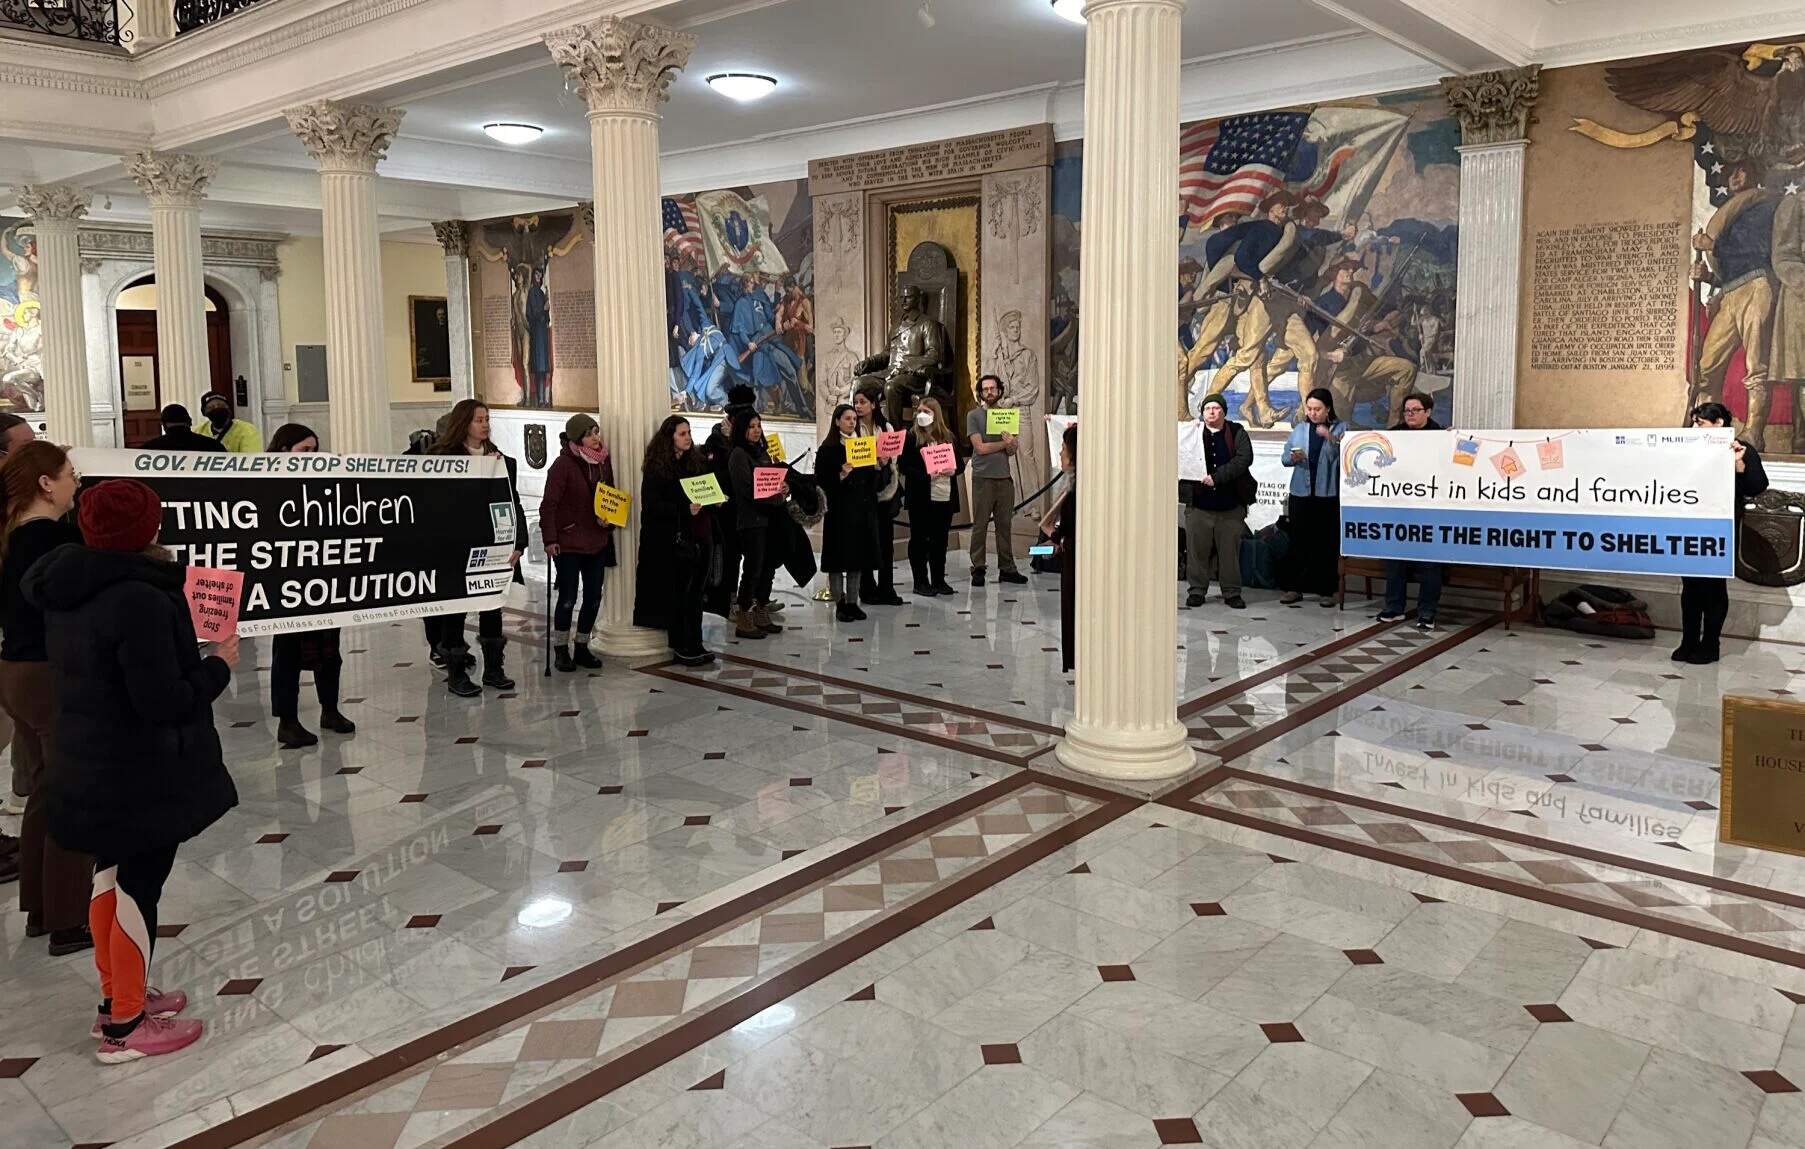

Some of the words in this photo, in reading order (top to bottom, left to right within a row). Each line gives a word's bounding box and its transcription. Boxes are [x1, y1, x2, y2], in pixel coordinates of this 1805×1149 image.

[134, 453, 187, 471] GOV.
[192, 456, 282, 472] HEALEY:
[286, 456, 341, 473] STOP
[345, 457, 418, 473] SHELTER
[421, 459, 470, 474] CUTS!
[1257, 490, 1281, 498] STATES
[1367, 475, 1439, 500] Invest
[1448, 480, 1467, 500] in
[1478, 475, 1526, 502] kids
[1537, 477, 1579, 504] and
[1588, 476, 1700, 506] families
[160, 500, 259, 530] TING
[279, 483, 415, 528] children
[1344, 521, 1434, 543] RESTORE
[1439, 525, 1481, 546] THE
[1487, 527, 1557, 550] RIGHT
[1563, 530, 1595, 551] TO
[1600, 532, 1726, 557] SHELTER!
[162, 542, 238, 571] THE
[250, 537, 384, 570] STREET
[195, 578, 226, 591] shelter
[225, 582, 234, 592] of
[246, 582, 271, 612] A
[280, 569, 437, 609] SOLUTION
[468, 578, 494, 590] MLRI
[192, 591, 207, 601] out
[208, 593, 235, 608] families
[199, 603, 229, 621] freezing
[203, 618, 221, 633] Stop
[237, 618, 334, 634] esForAllMass.org
[103, 1037, 126, 1049] HOKA
